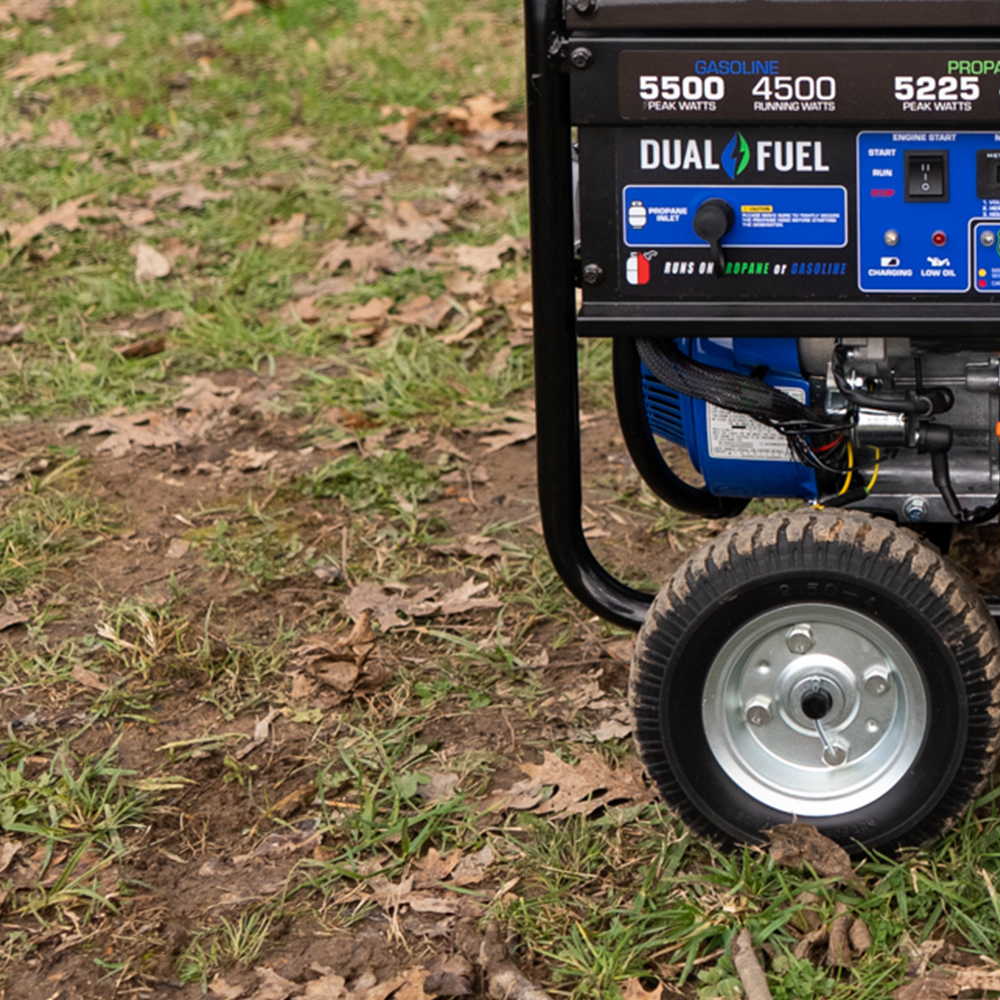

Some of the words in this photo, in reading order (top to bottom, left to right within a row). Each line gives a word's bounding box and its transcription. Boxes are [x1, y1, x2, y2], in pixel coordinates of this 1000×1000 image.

[694, 60, 779, 75] GASOLINE
[639, 76, 725, 100] 5500
[752, 76, 836, 100] 4500
[894, 76, 980, 100] 5225
[648, 102, 676, 111] PEAK
[678, 102, 716, 111] WATTS
[754, 102, 799, 111] RUNNING
[801, 102, 835, 111] WATTS
[903, 102, 934, 111] PEAK
[935, 102, 972, 111] WATTS
[640, 139, 719, 170] DUAL
[756, 141, 830, 172] FUEL
[871, 189, 895, 197] STOP
[648, 207, 688, 215] PROPANE
[664, 262, 694, 274] RUNS
[699, 262, 714, 274] ON
[725, 262, 770, 274] ROPANE
[773, 264, 787, 274] or
[791, 263, 847, 275] GASOLINE
[868, 269, 912, 277] CHARGING
[921, 269, 941, 277] LOW
[943, 269, 956, 277] OIL
